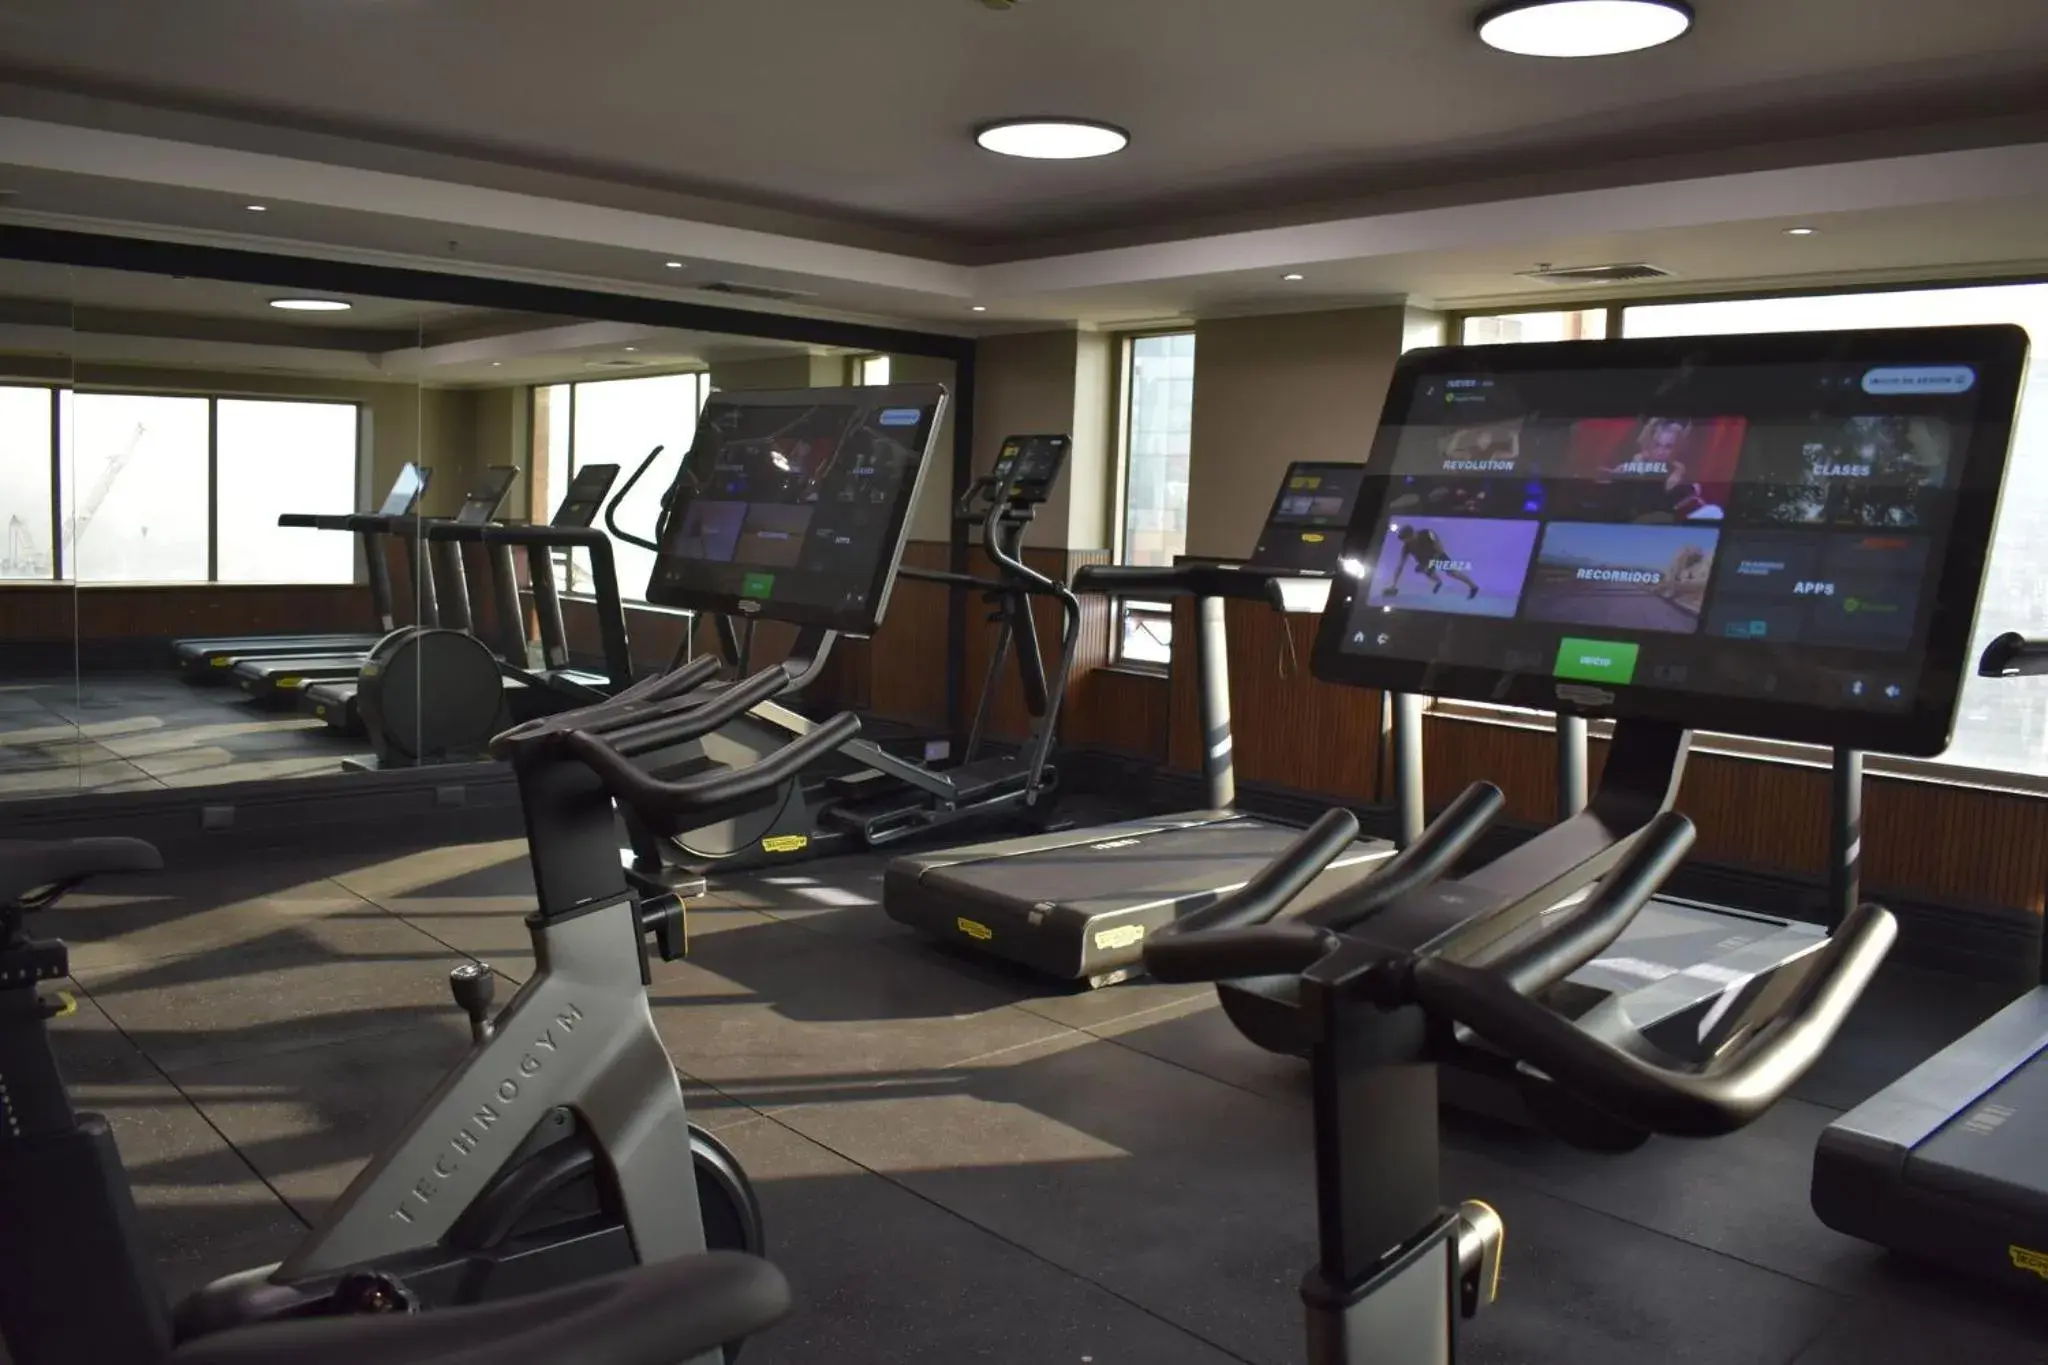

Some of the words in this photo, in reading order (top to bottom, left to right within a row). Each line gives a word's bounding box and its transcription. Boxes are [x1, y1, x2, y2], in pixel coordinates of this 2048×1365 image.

[1442, 460, 1515, 471] REVOLUTION
[1812, 464, 1870, 476] CLASES
[1428, 559, 1472, 571] FUERZA
[1576, 568, 1660, 584] RECORRIDOS
[1793, 581, 1834, 595] APPS
[390, 1003, 583, 1223] TECHNOGYM
